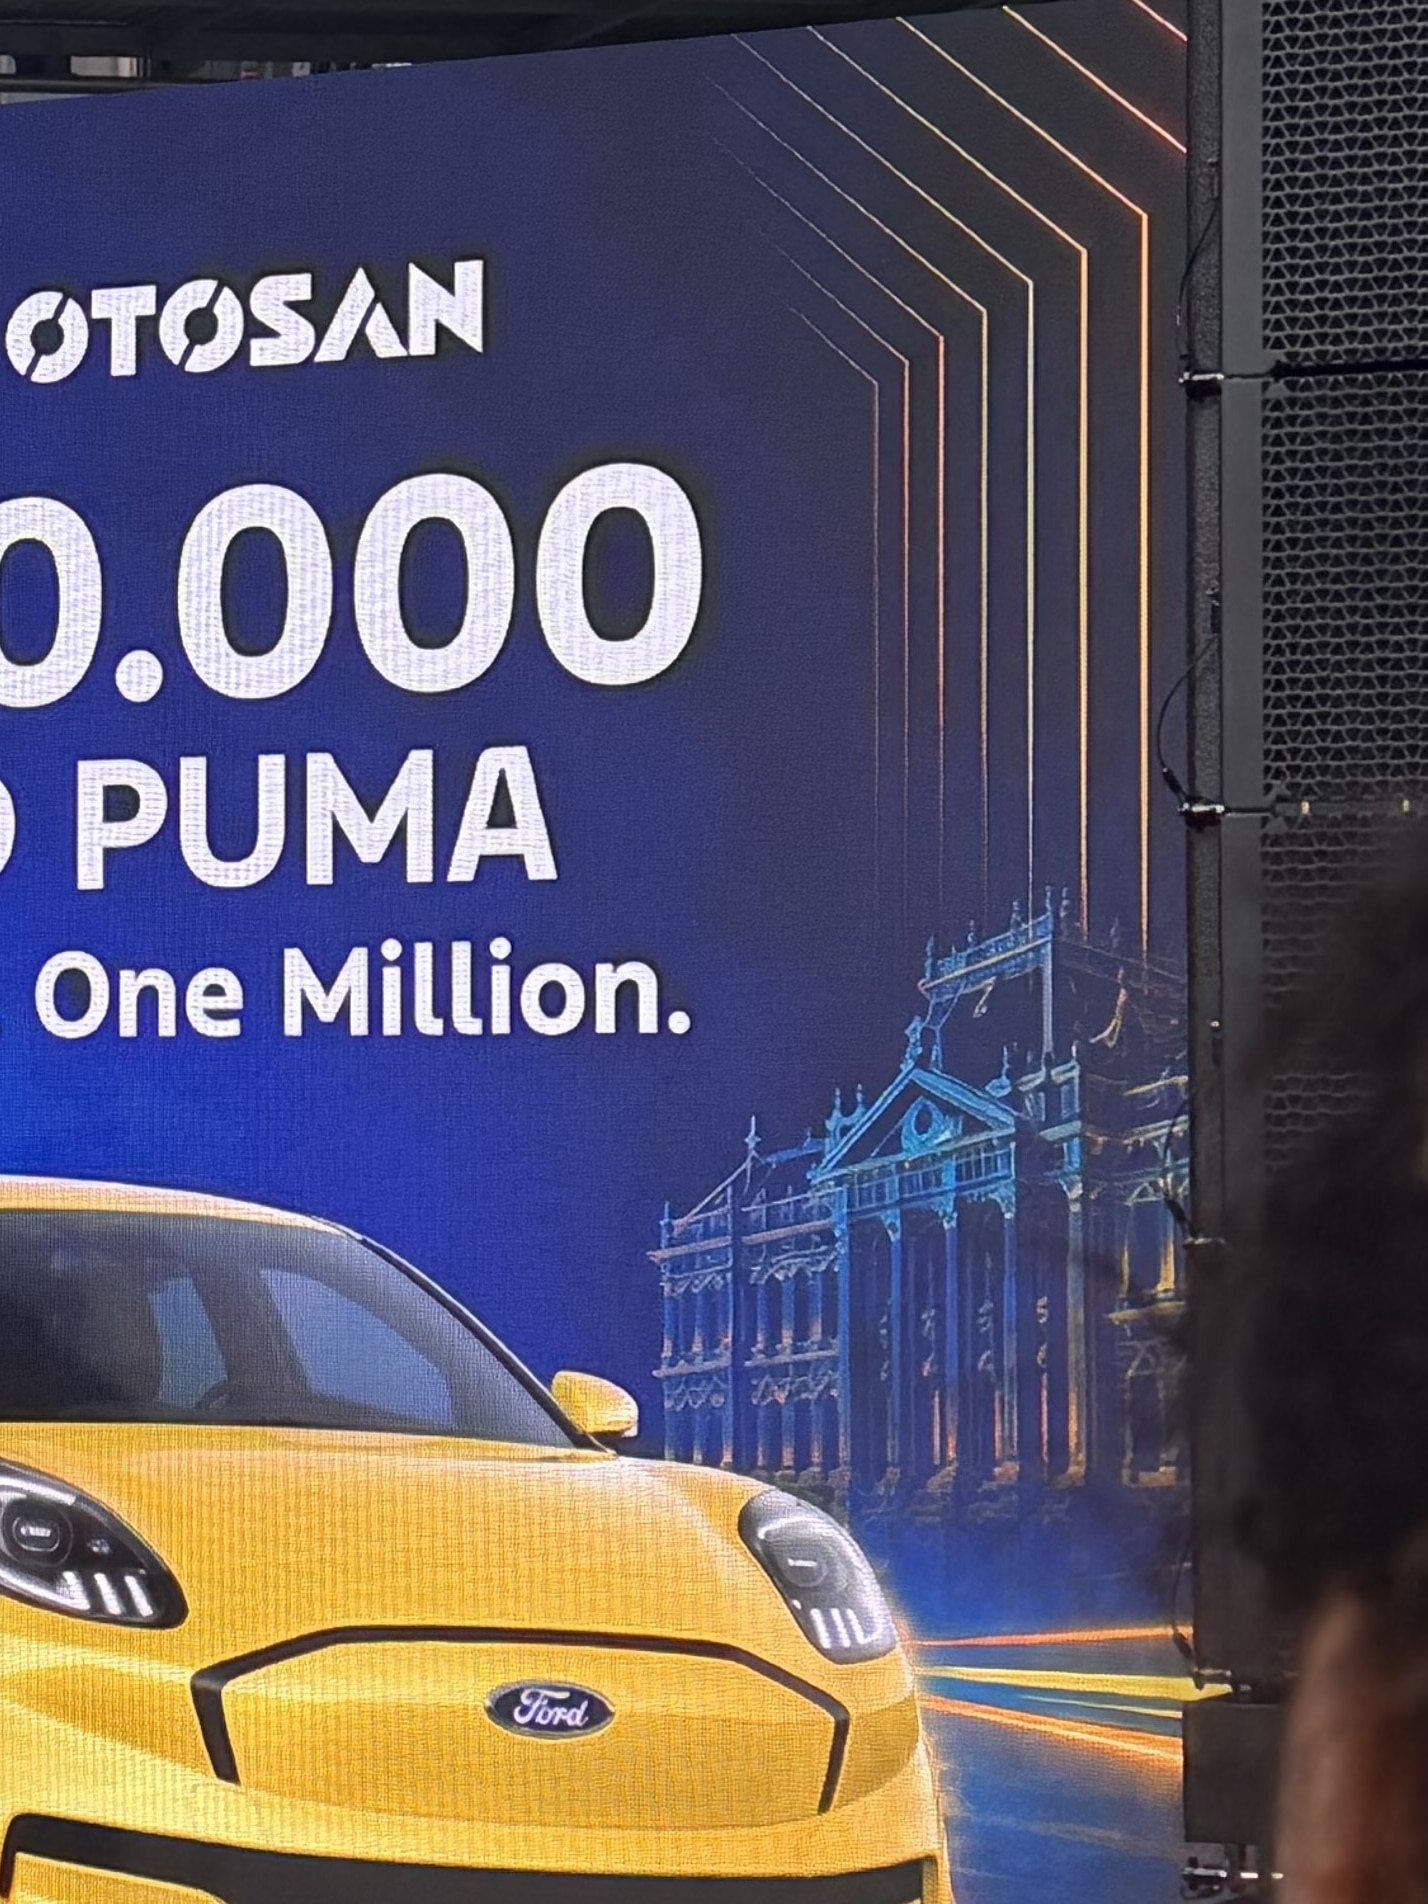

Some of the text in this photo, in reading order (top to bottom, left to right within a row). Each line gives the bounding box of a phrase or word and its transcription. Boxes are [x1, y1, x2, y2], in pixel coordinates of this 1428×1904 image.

[5, 259, 485, 384] OTOSAN
[77, 745, 559, 890] PUMA
[34, 950, 245, 1039] One
[283, 937, 692, 1037] Million.
[513, 1688, 590, 1727] Ford
